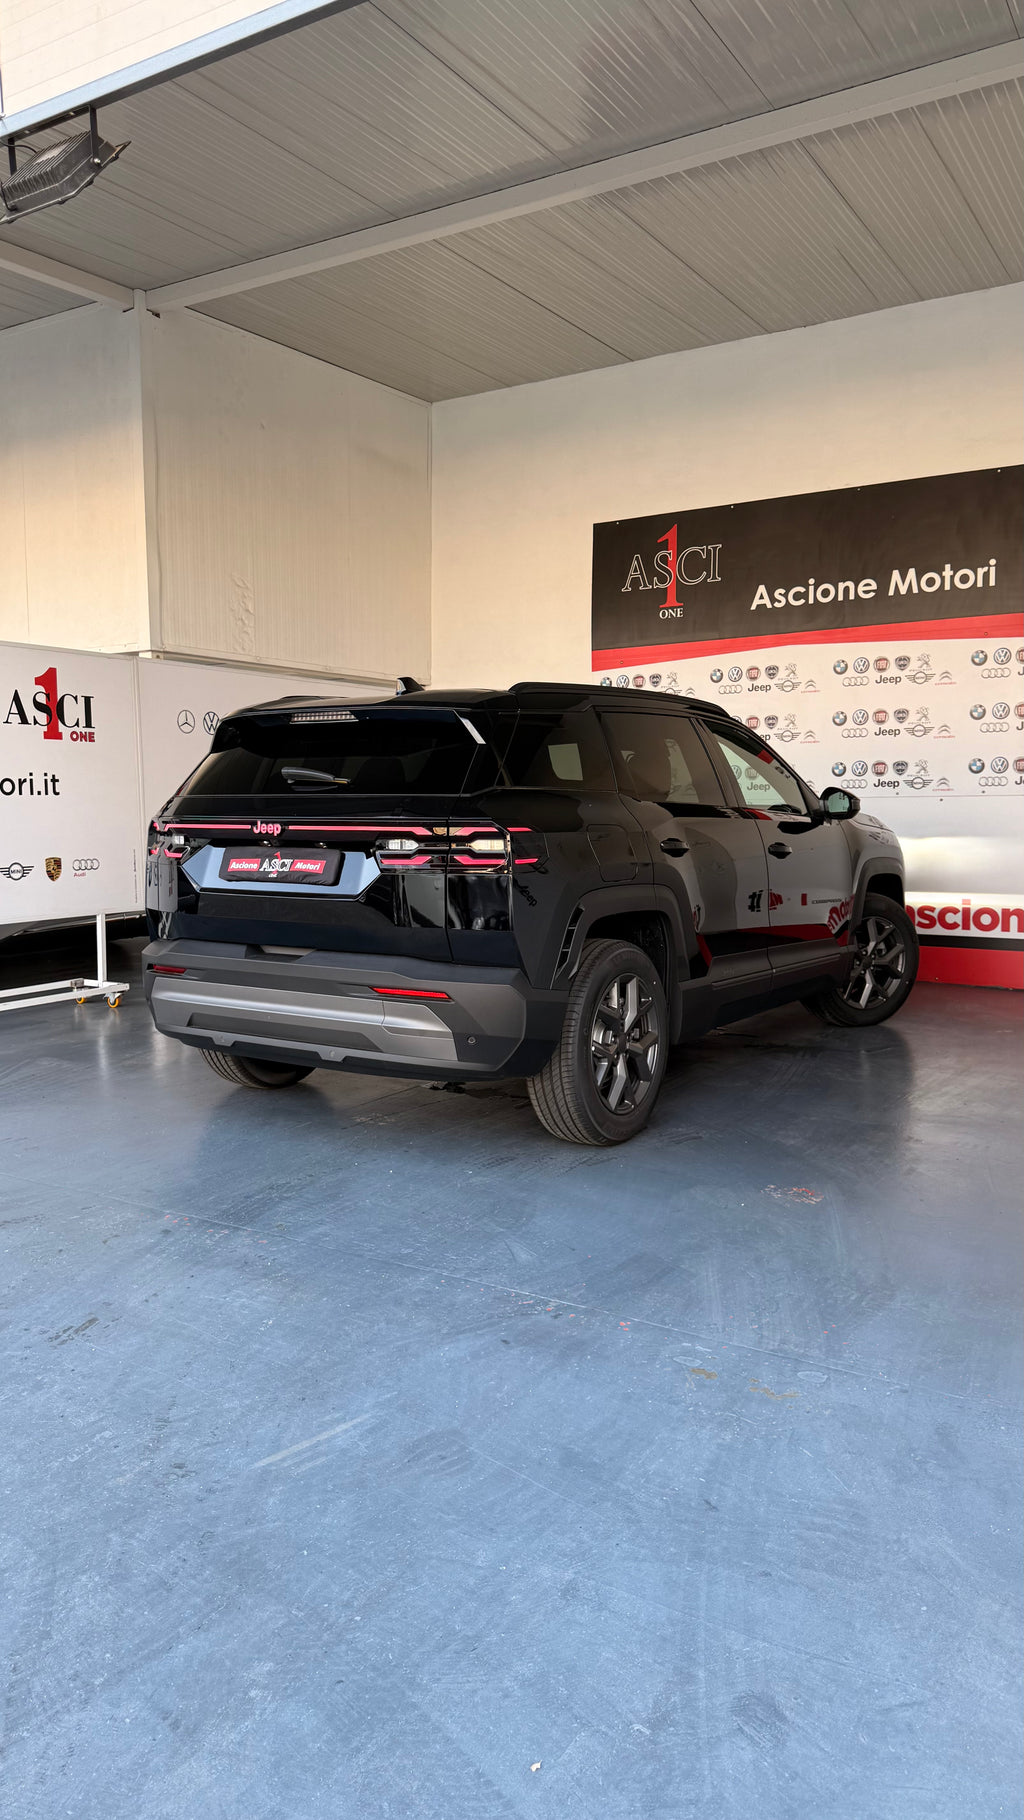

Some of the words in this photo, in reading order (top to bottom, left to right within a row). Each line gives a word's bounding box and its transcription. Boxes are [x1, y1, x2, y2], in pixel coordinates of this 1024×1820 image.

[621, 543, 723, 592] ASCI
[750, 578, 878, 611] Ascione
[888, 558, 997, 597] Motori
[659, 607, 684, 619] ONE
[875, 675, 902, 685] Jeep
[748, 683, 771, 693] Jeep
[3, 689, 95, 728] ASCI
[70, 731, 95, 742] ONE
[874, 727, 901, 737] Jeep
[0, 772, 60, 796] ori.it
[747, 782, 771, 792] Jeep
[873, 778, 900, 789] Jeep
[252, 820, 282, 836] Jeep
[230, 861, 258, 869] Ascione
[294, 861, 321, 870] Motori
